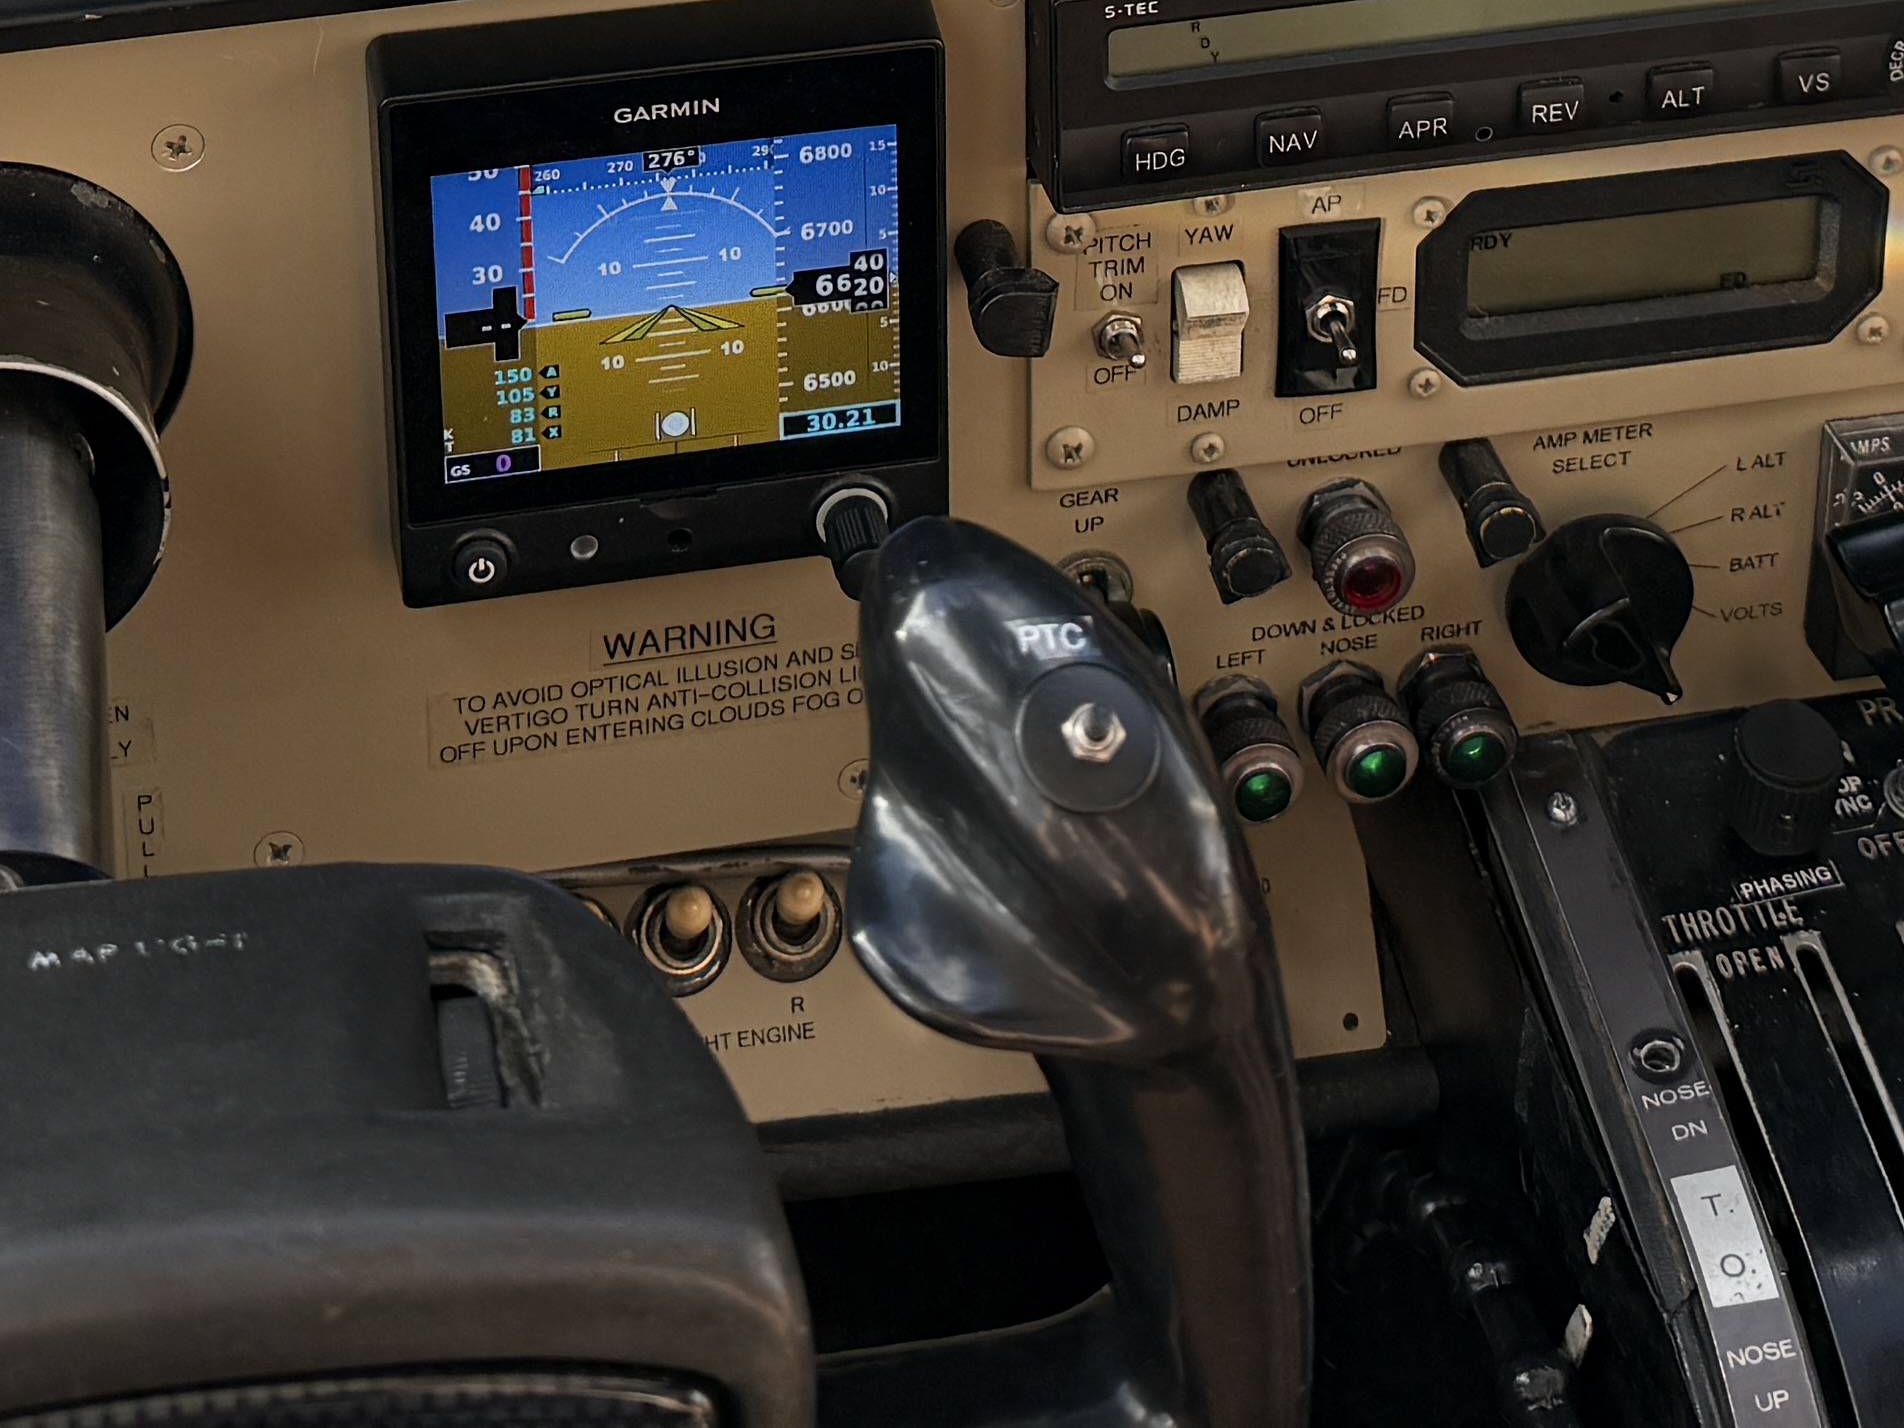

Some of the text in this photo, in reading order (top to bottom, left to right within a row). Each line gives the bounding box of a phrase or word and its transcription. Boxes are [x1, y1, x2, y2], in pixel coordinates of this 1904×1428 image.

[1104, 0, 1160, 18] S-TEC
[1798, 70, 1830, 95] VS
[614, 97, 720, 125] GARMIN
[1661, 85, 1705, 111] ALT
[1532, 100, 1579, 125] REV
[1399, 115, 1448, 141] APR
[1269, 129, 1318, 156] NAV
[1135, 146, 1186, 173] HDG
[1184, 223, 1235, 245] YAW
[806, 407, 876, 432] 30.21
[1532, 422, 1654, 452] AMP METER
[603, 613, 776, 660] WARNING
